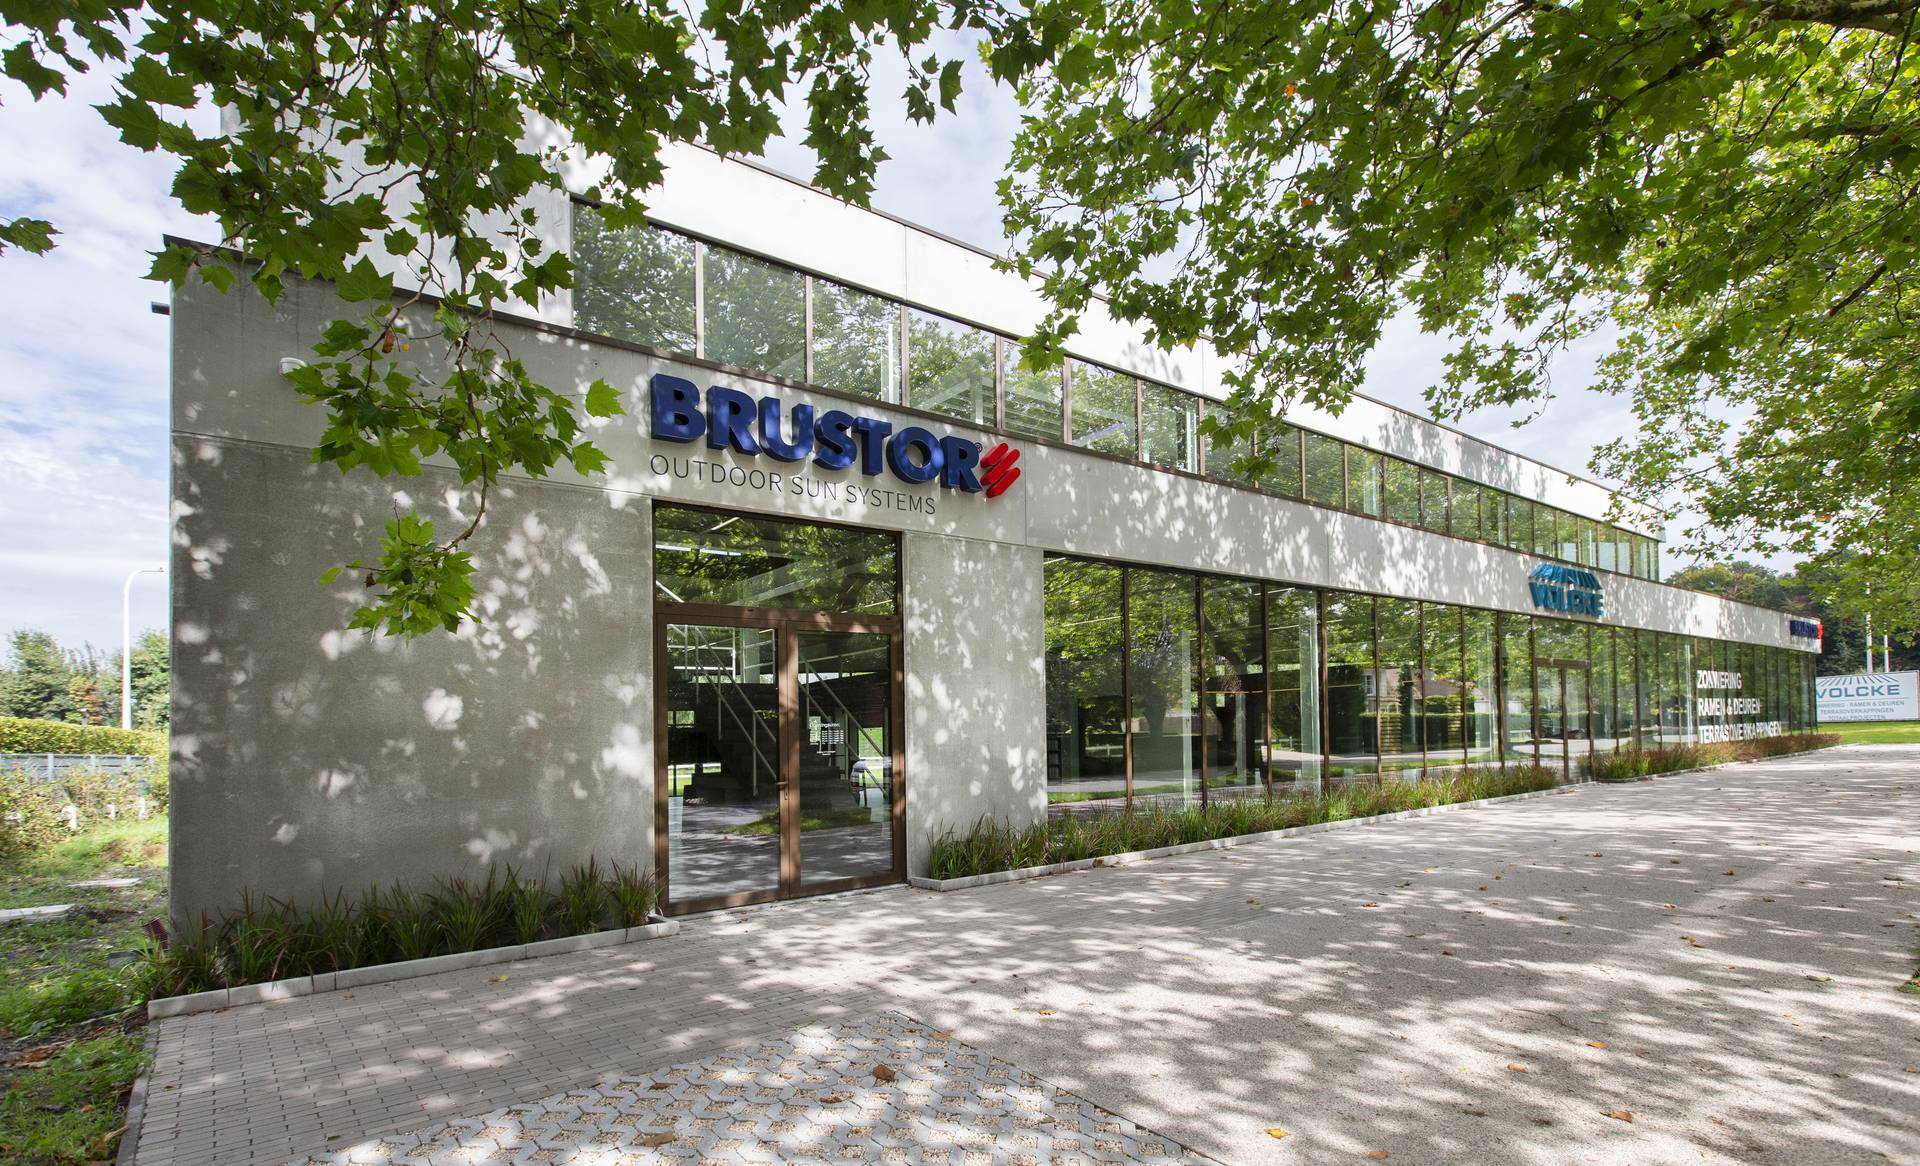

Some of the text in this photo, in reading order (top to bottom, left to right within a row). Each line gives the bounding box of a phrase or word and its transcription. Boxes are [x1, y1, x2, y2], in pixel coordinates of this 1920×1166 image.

[650, 373, 983, 493] BRUSTOR
[650, 454, 936, 515] OUTDOOR SUN SYSTEMS
[1697, 670, 1742, 689] ZONWERING
[1816, 684, 1900, 698] VOLCKE
[1698, 698, 1760, 716] RAMEN & DEUREN
[1698, 721, 1782, 744] TERRASOVERKAPPINGEN
